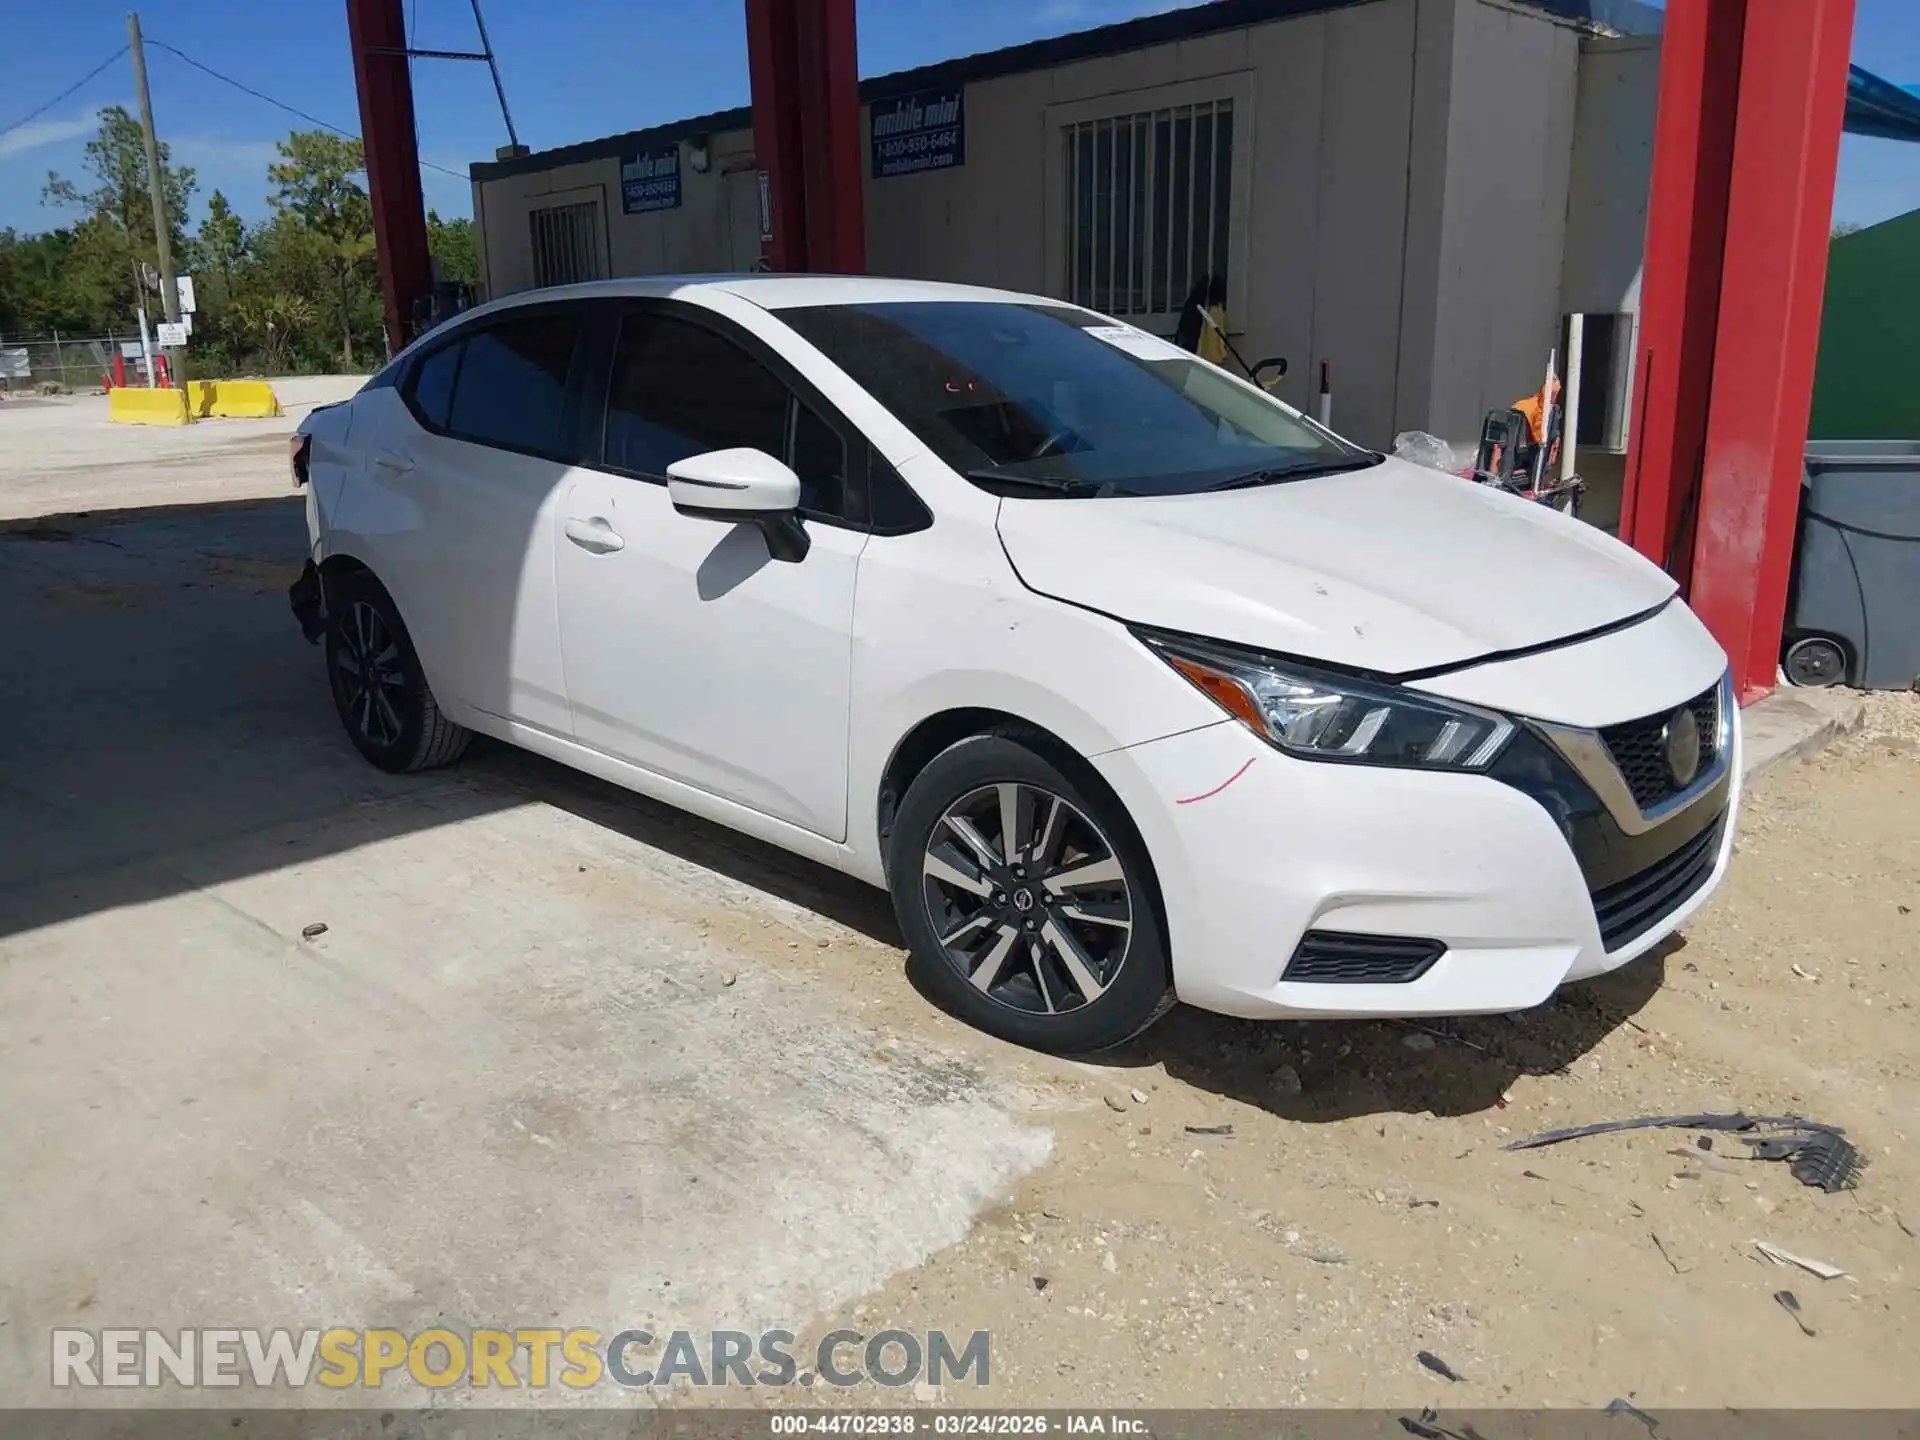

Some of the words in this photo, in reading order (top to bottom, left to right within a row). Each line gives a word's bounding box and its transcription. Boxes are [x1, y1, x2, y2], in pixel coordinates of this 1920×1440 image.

[874, 96, 923, 136] mobile
[924, 93, 961, 127] mini
[623, 151, 653, 182] mobile
[655, 150, 677, 177] mini
